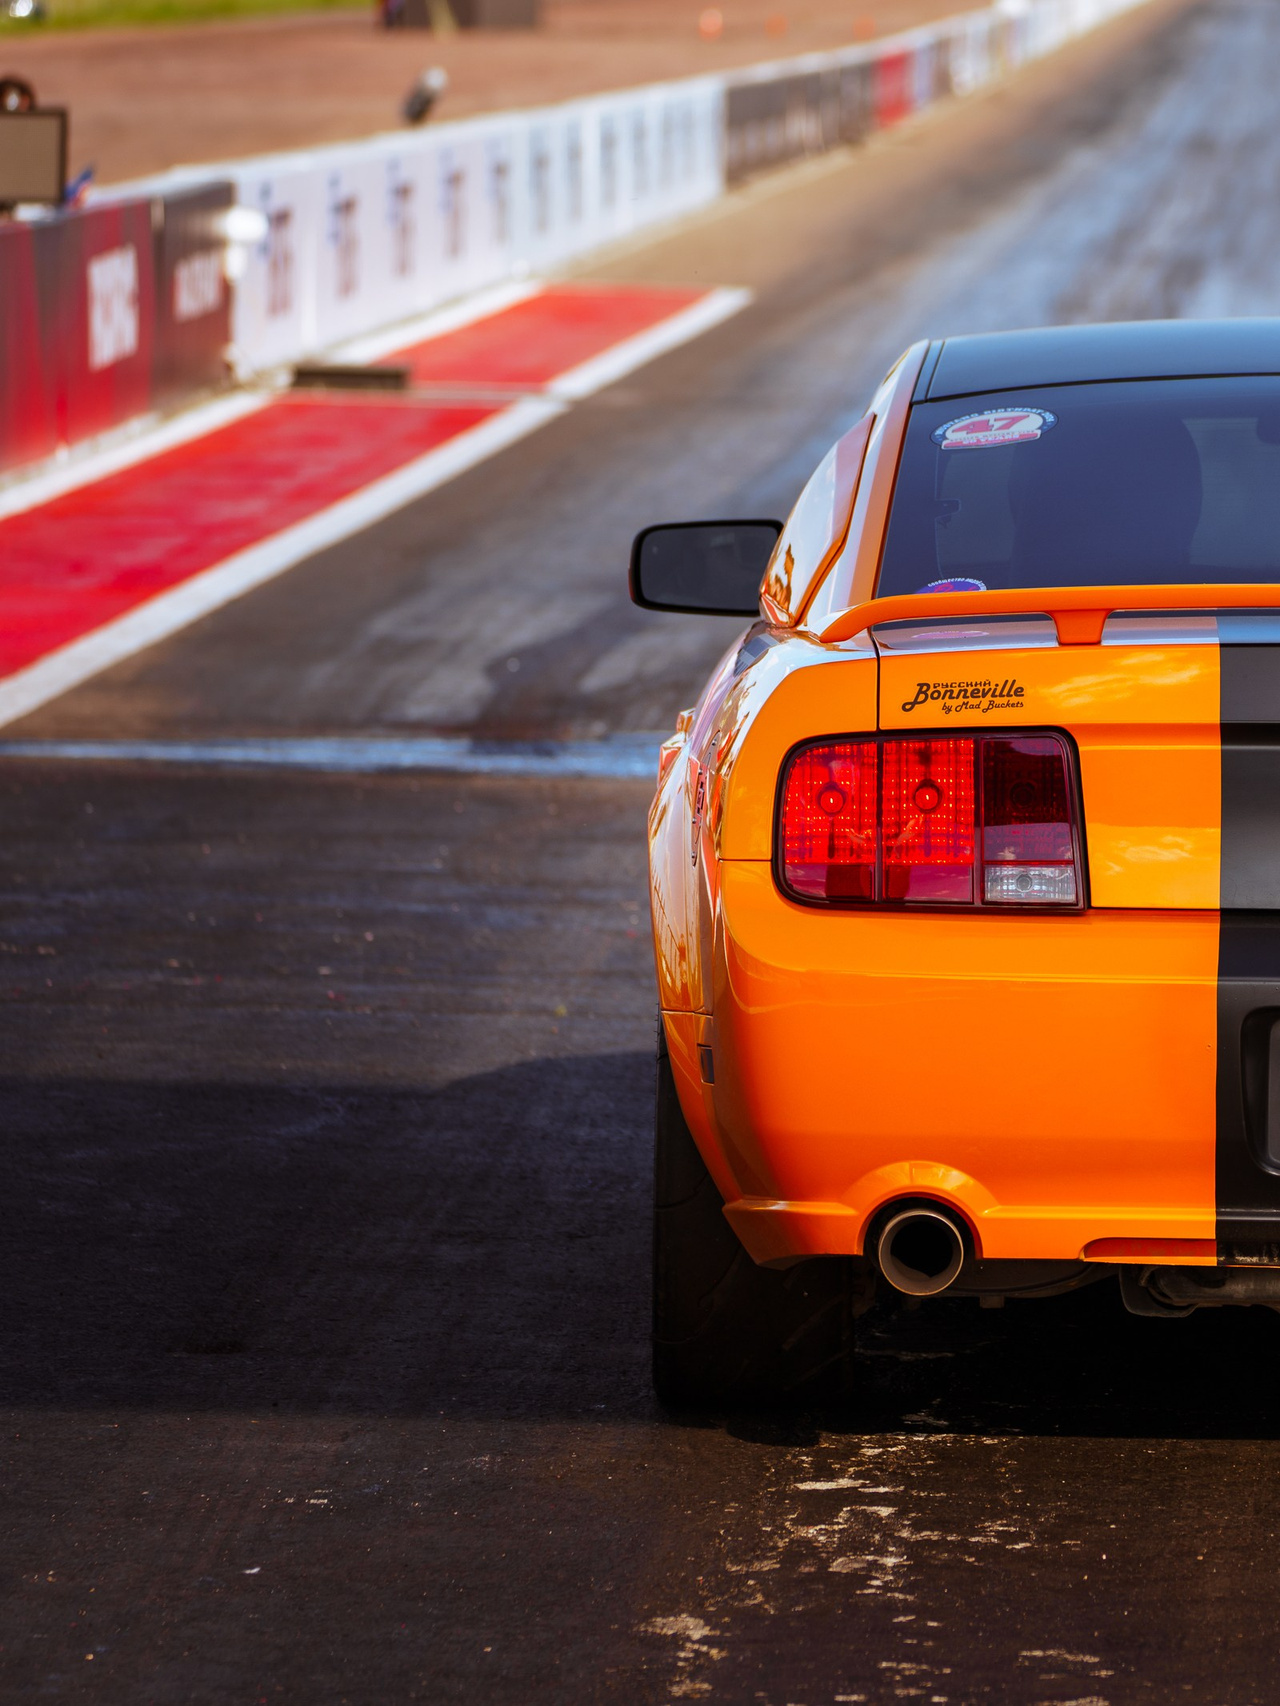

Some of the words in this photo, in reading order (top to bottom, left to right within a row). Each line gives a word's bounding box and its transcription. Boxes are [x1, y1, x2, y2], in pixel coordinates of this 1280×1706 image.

[951, 414, 1030, 435] 47
[932, 679, 992, 689] РУССКИЙ
[901, 679, 1025, 712] Bonneville
[941, 701, 953, 714] by
[954, 700, 982, 713] Mad
[982, 700, 1024, 714] Buckets
